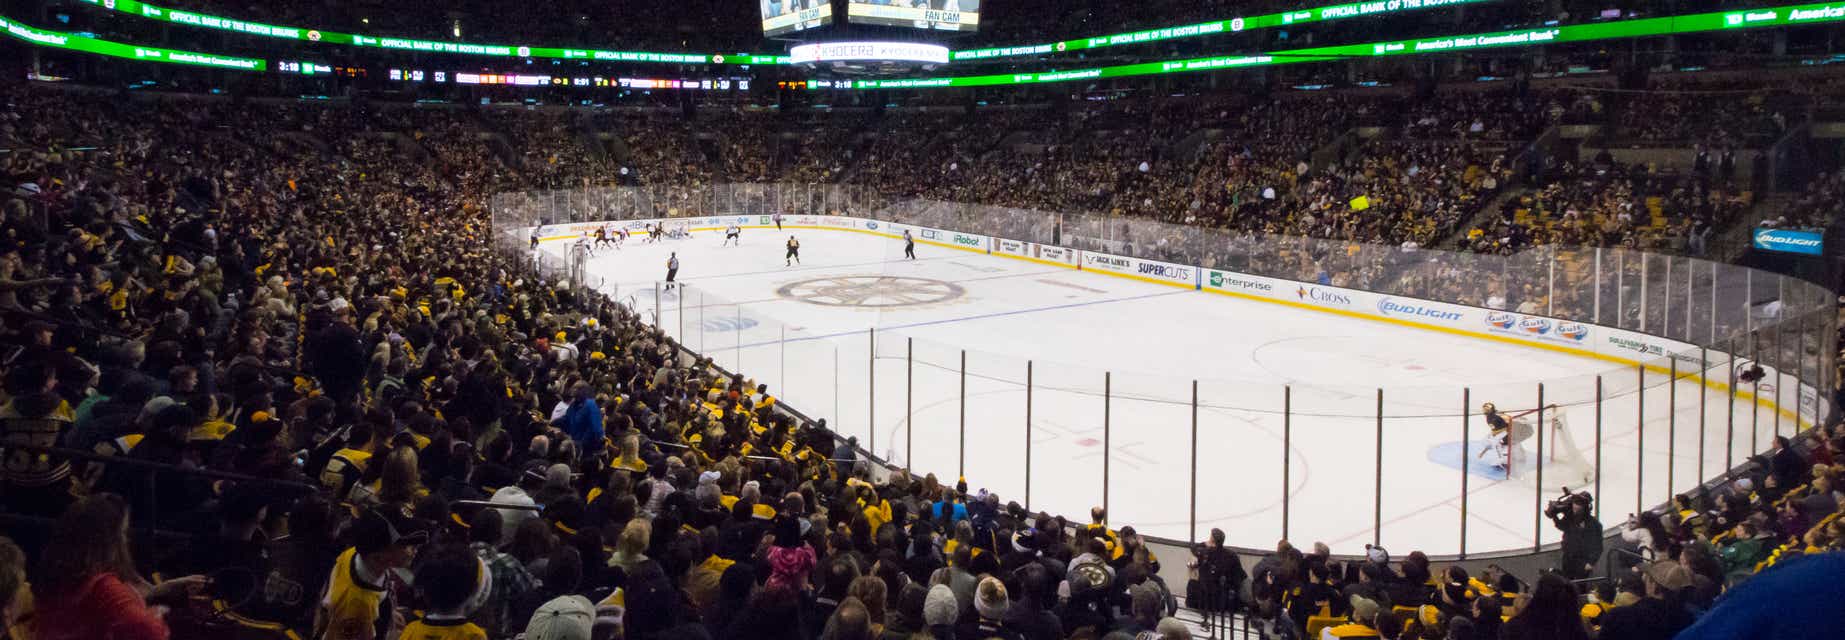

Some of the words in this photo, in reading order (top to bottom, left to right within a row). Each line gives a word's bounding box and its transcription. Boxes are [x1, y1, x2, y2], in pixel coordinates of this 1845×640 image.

[925, 10, 940, 20] FAN
[942, 12, 960, 22] CAM
[1321, 6, 1358, 18] OFFICIAL
[1360, 1, 1385, 13] BANK
[169, 11, 200, 24] OFFICIAL
[201, 17, 220, 27] BANK
[221, 20, 231, 28] OF
[231, 21, 244, 30] THE
[1110, 34, 1133, 44] OFFICIAL
[1134, 32, 1150, 40] BANK
[1160, 29, 1171, 37] THE
[1173, 26, 1198, 36] BOSTON
[1415, 40, 1454, 50] America's
[1455, 38, 1476, 46] Most
[1477, 33, 1528, 45] Convenient
[1529, 30, 1554, 41] Bank
[381, 39, 412, 48] OFFICIAL
[413, 41, 433, 50] BANK
[458, 45, 484, 53] BOSTON
[821, 44, 873, 58] KYOCERA
[955, 51, 976, 59] OFFICIAL
[1012, 46, 1034, 54] BOSTON
[953, 232, 979, 247] iRobot
[1759, 235, 1786, 243] BUD
[1786, 238, 1822, 247] LIGHT
[1137, 262, 1189, 280] SUPERCUTS
[1214, 275, 1272, 291] enterprise
[1382, 301, 1416, 315] BUD
[1416, 306, 1464, 321] LIGHT
